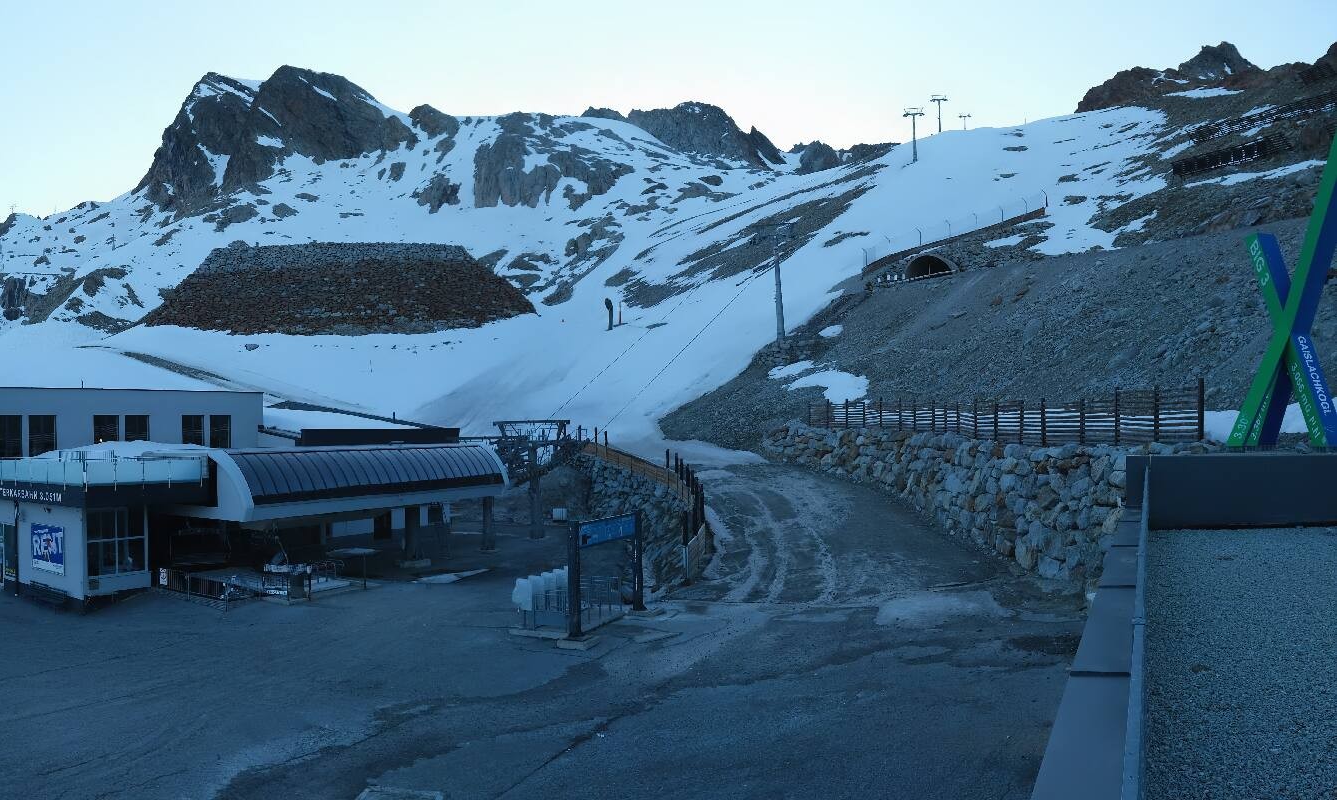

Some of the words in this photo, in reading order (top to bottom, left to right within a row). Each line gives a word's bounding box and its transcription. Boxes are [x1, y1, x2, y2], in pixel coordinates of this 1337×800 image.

[1250, 239, 1265, 273] BIG
[1260, 272, 1270, 286] 3
[32, 531, 63, 556] RENT
